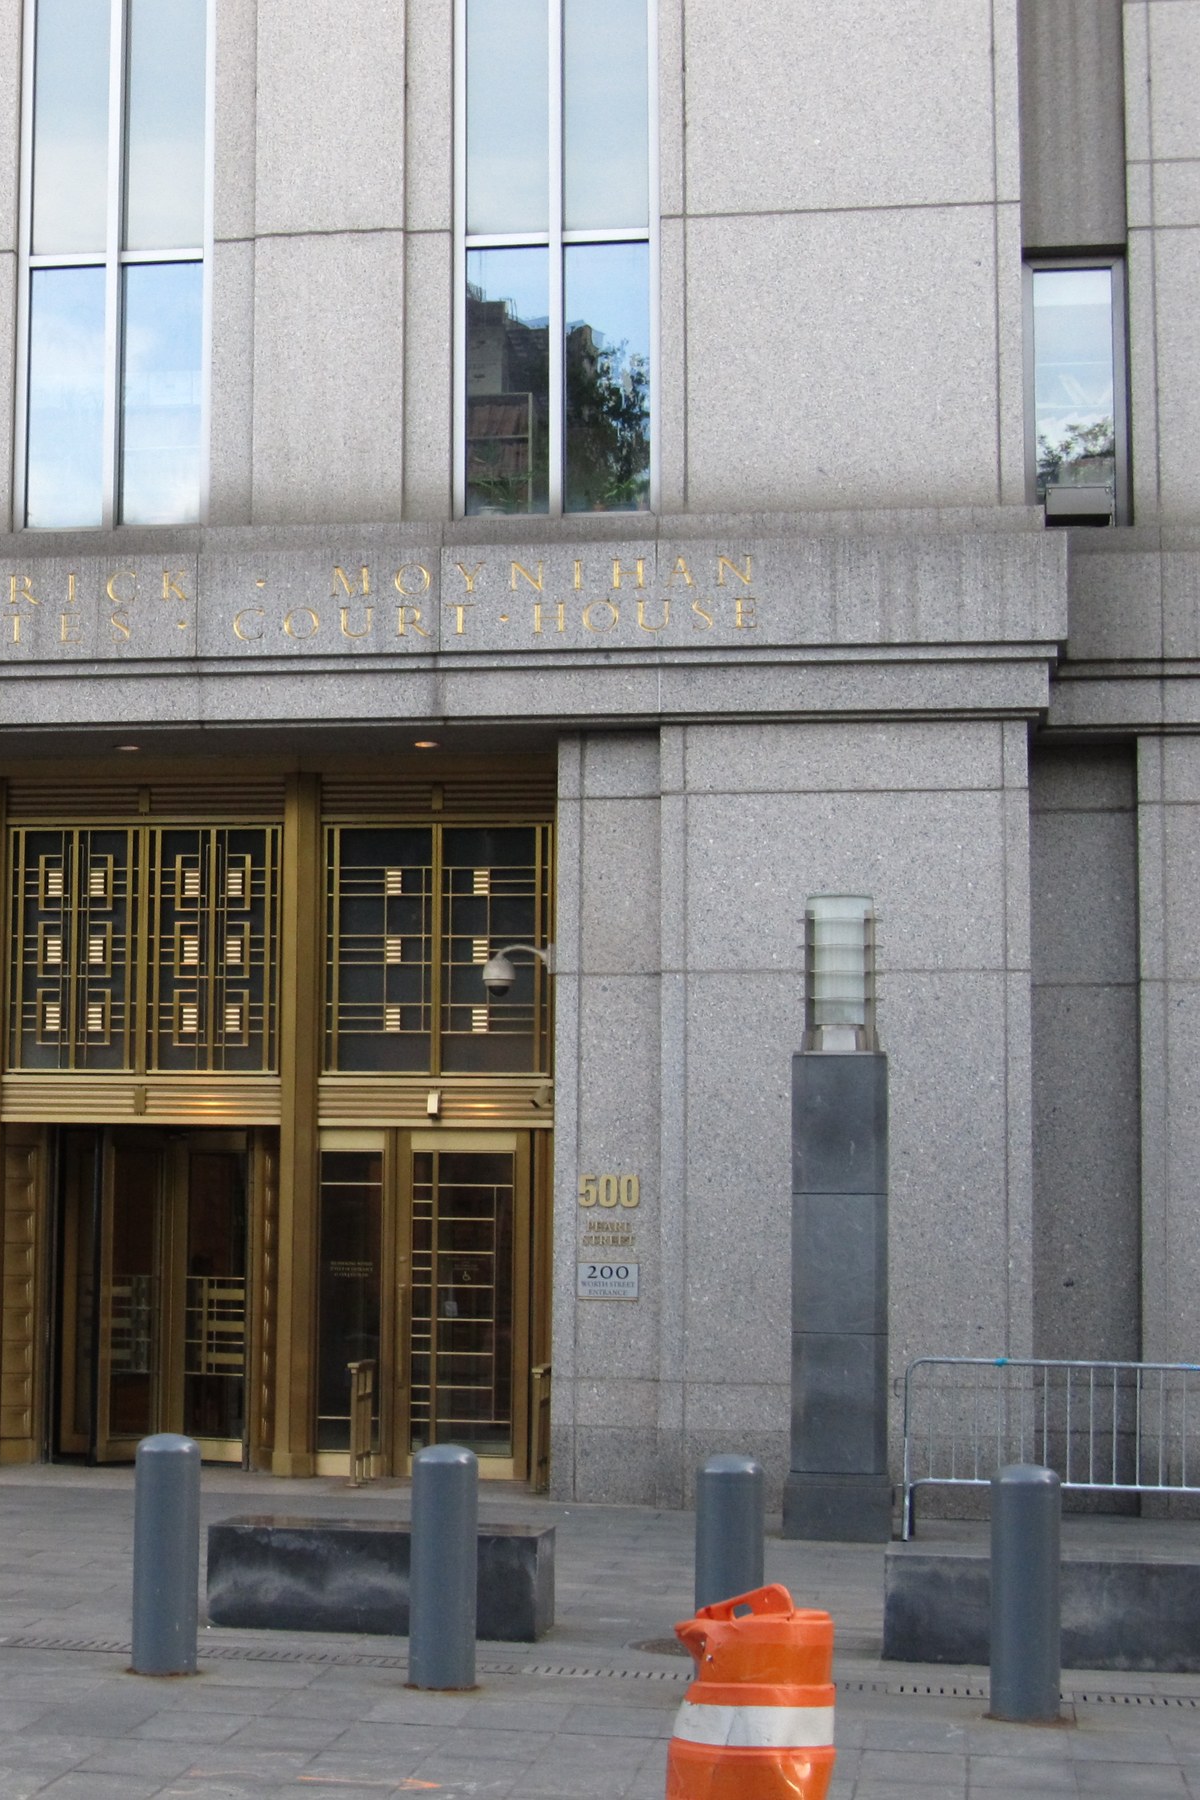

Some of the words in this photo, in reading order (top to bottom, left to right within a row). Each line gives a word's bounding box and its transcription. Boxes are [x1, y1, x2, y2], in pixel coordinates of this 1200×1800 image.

[330, 553, 755, 598] MOYNIHAN
[232, 604, 475, 642] COURT
[531, 596, 758, 636] HOUSE
[578, 1173, 639, 1208] 500
[587, 1265, 629, 1280] 200
